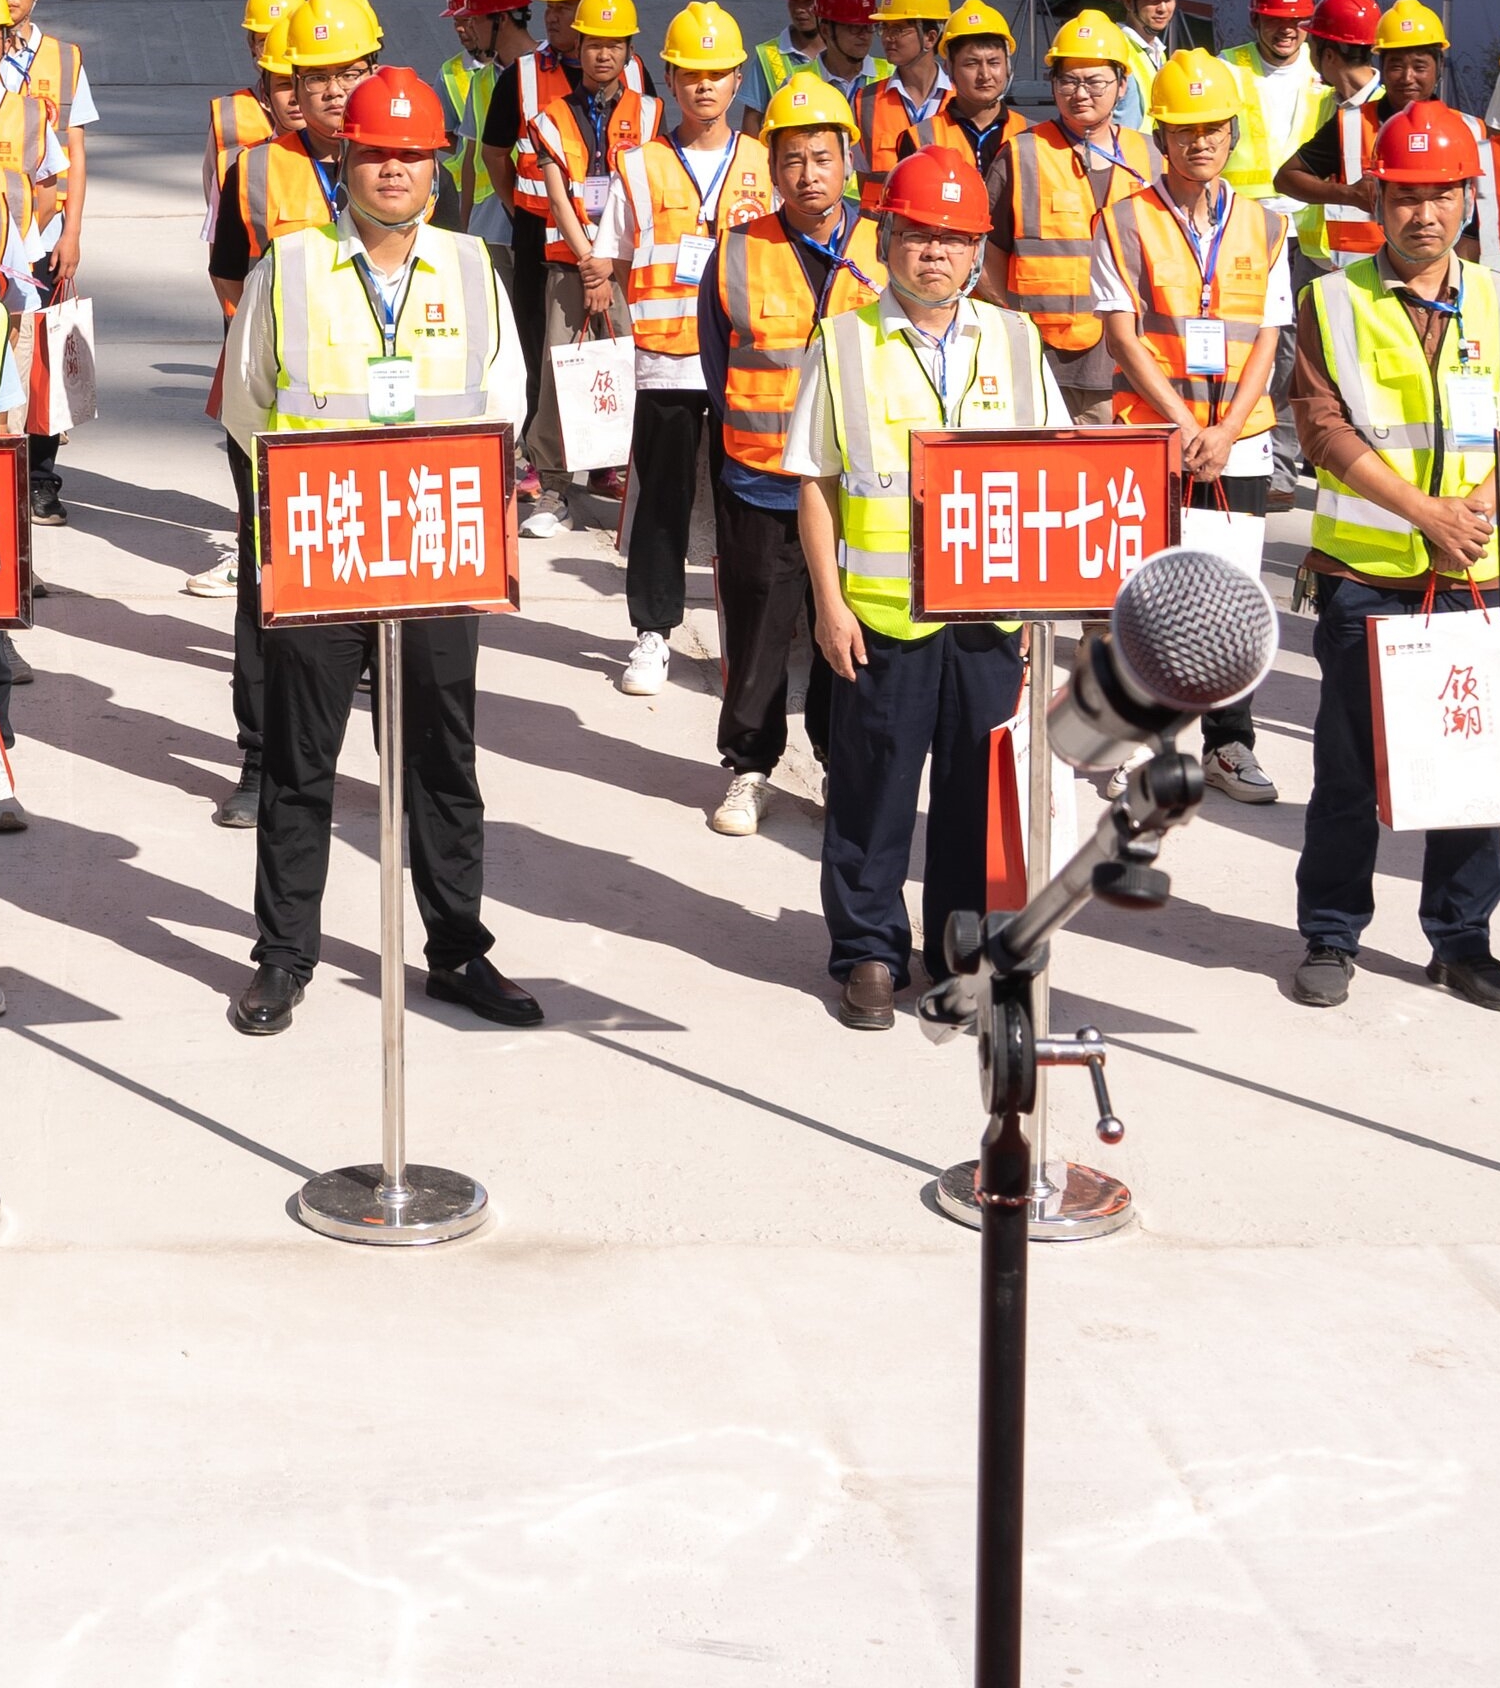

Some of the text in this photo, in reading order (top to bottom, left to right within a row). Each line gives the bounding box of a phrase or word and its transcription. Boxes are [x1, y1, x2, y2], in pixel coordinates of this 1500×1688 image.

[285, 463, 487, 588] 中铁上海局
[938, 466, 1148, 585] 中国十七冶
